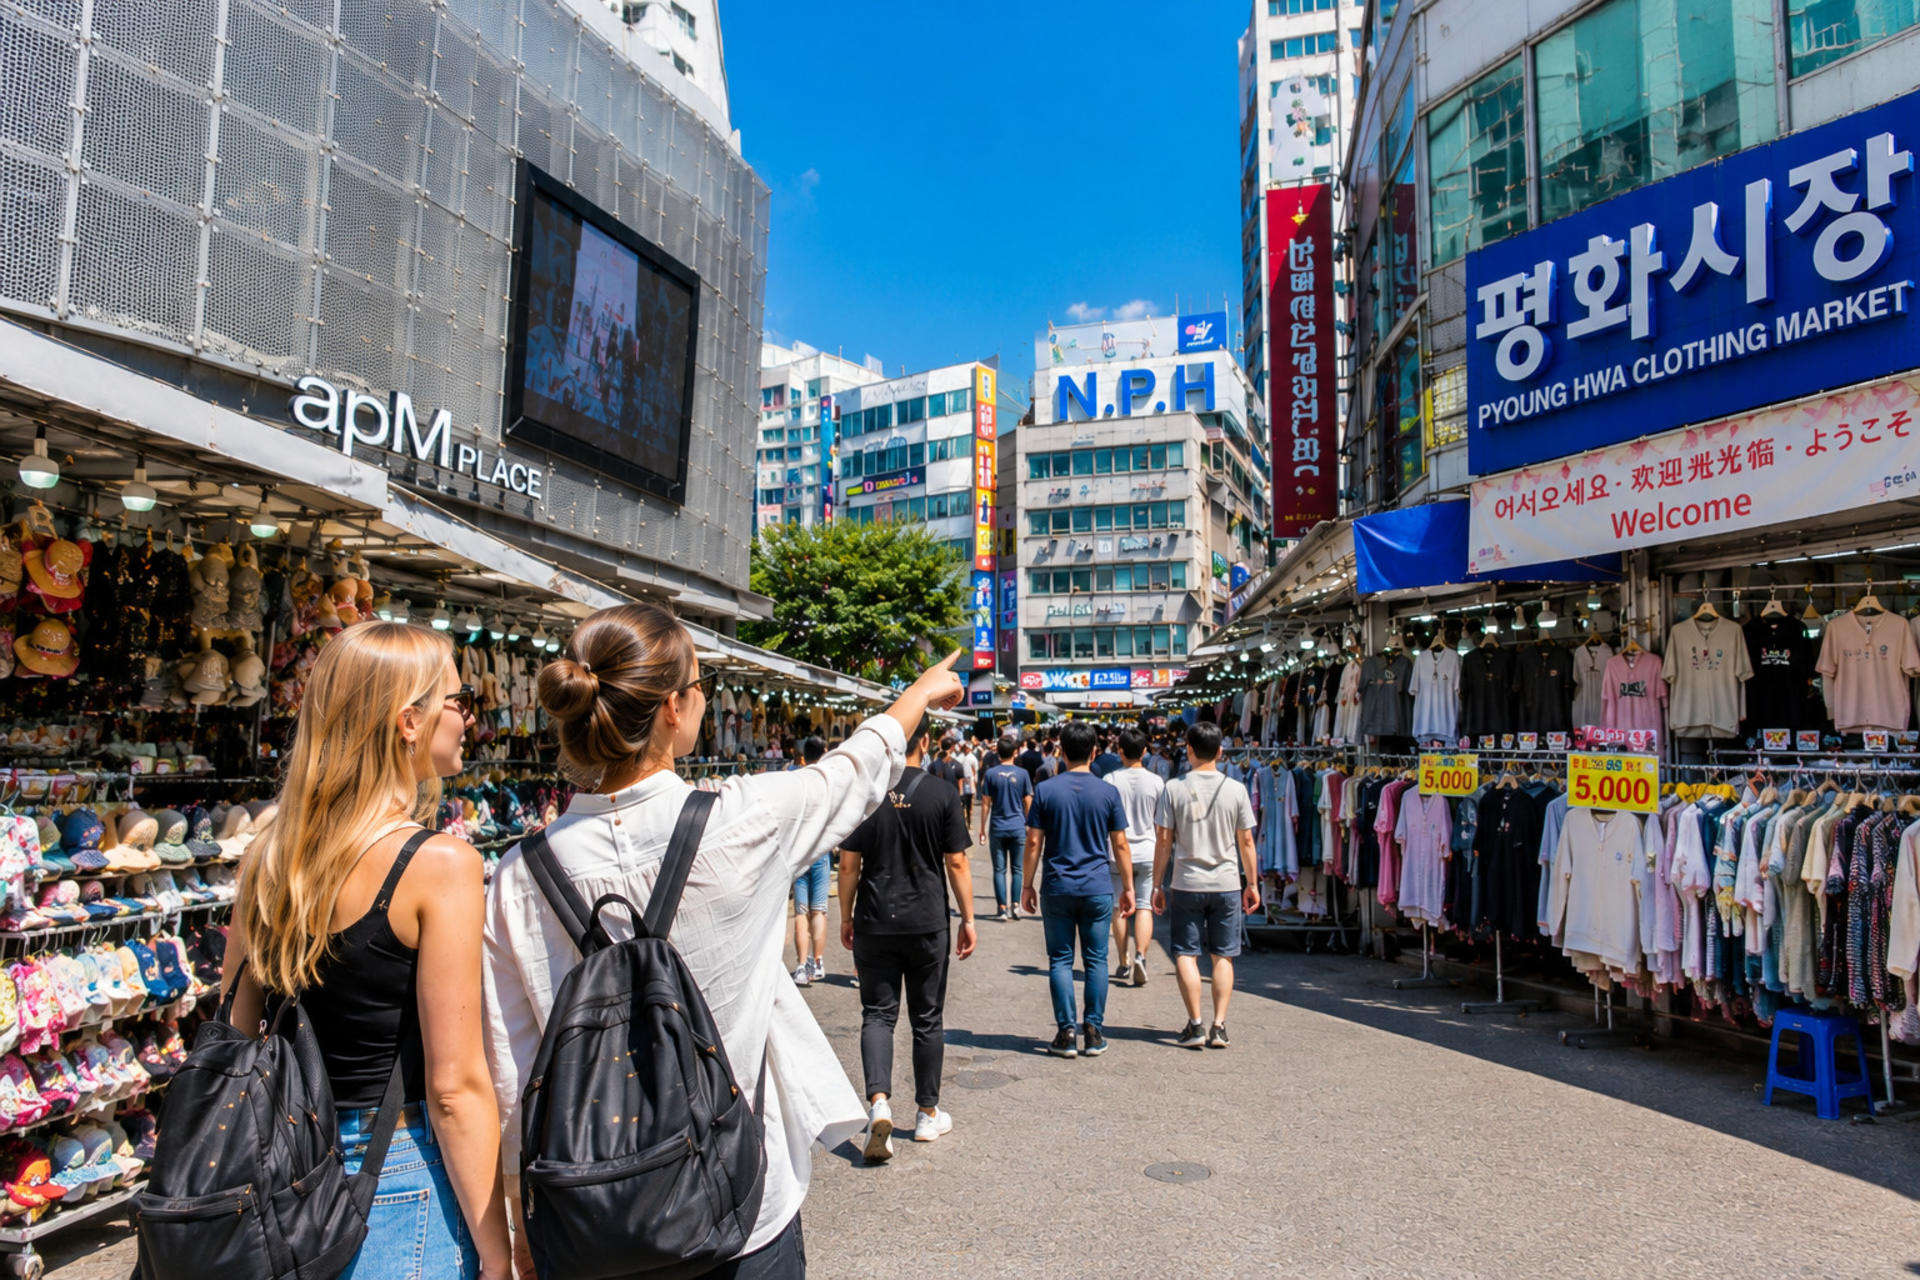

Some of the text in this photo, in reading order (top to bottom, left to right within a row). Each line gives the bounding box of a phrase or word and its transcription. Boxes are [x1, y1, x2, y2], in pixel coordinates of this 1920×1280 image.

[1476, 132, 1913, 382] 평화시장
[1058, 361, 1215, 421] N.P.H
[1478, 280, 1914, 430] PYOUNG HWA CLOTHING MARKET
[289, 375, 542, 500] apM PLACE
[1494, 473, 1610, 521] 어서오세요
[1805, 410, 1912, 456] ようこそ
[1611, 493, 1752, 539] Welcome
[1575, 774, 1650, 805] 5,000
